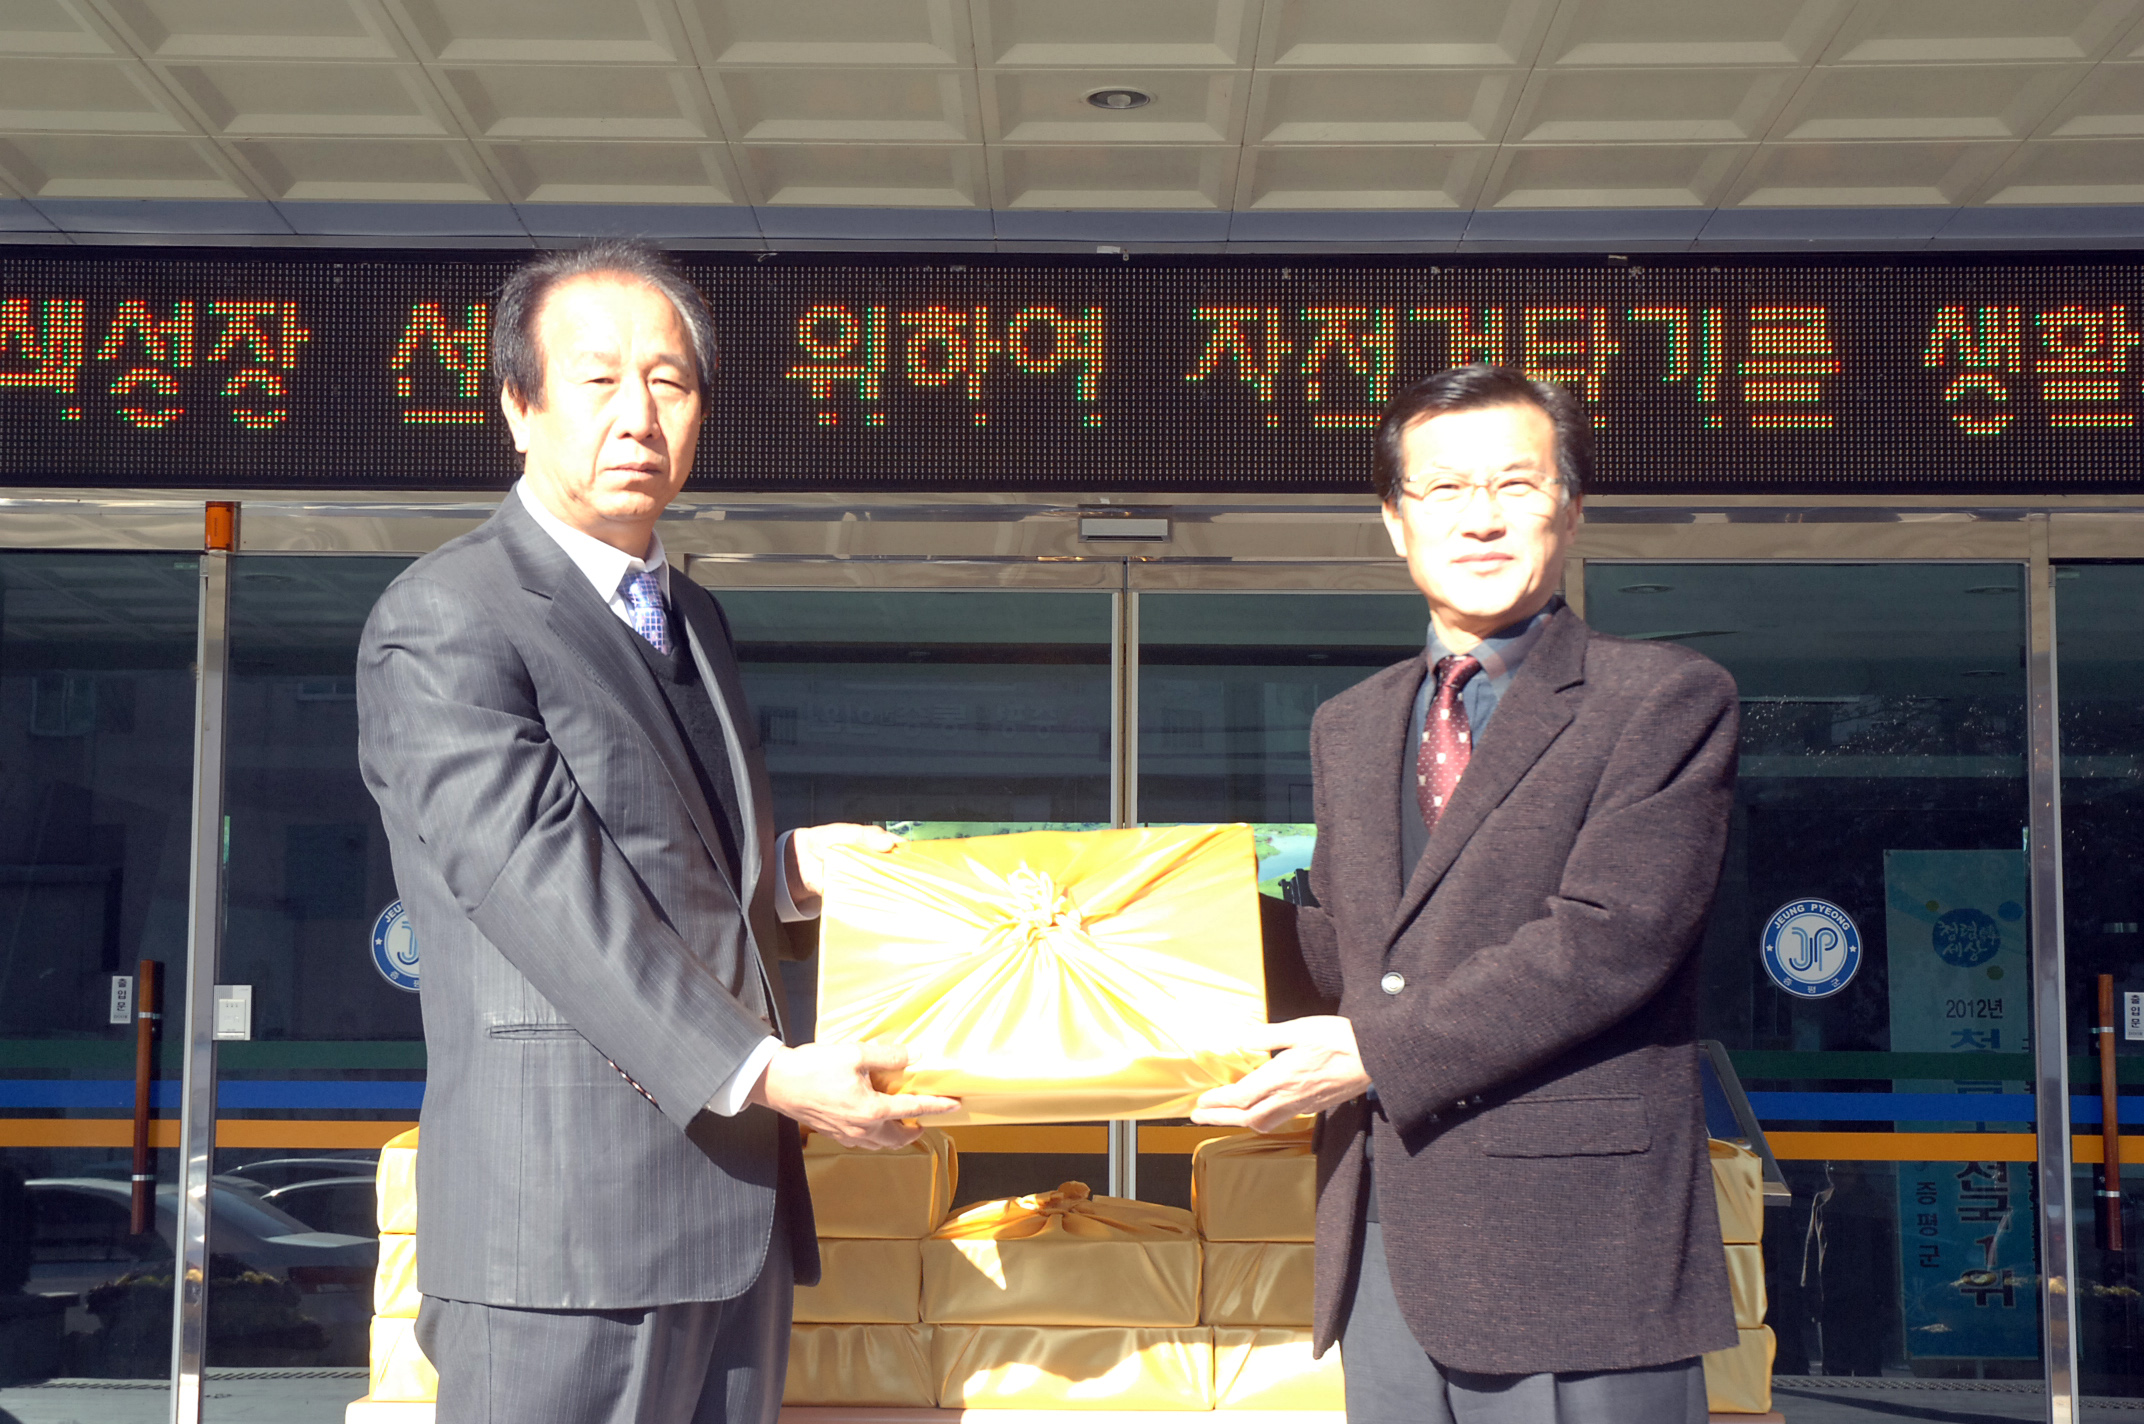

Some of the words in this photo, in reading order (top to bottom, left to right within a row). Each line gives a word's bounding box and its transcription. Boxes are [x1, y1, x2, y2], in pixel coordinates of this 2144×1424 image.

[785, 305, 1103, 428] 위하여
[1774, 904, 1805, 929] JEUNG
[1811, 903, 1851, 931] PYEONG
[1942, 940, 1988, 962] 세상
[116, 978, 127, 1012] 출입문
[1946, 998, 2004, 1020] 2012년
[2130, 994, 2141, 1028] 출입문
[1914, 1181, 1940, 1269] 증평군
